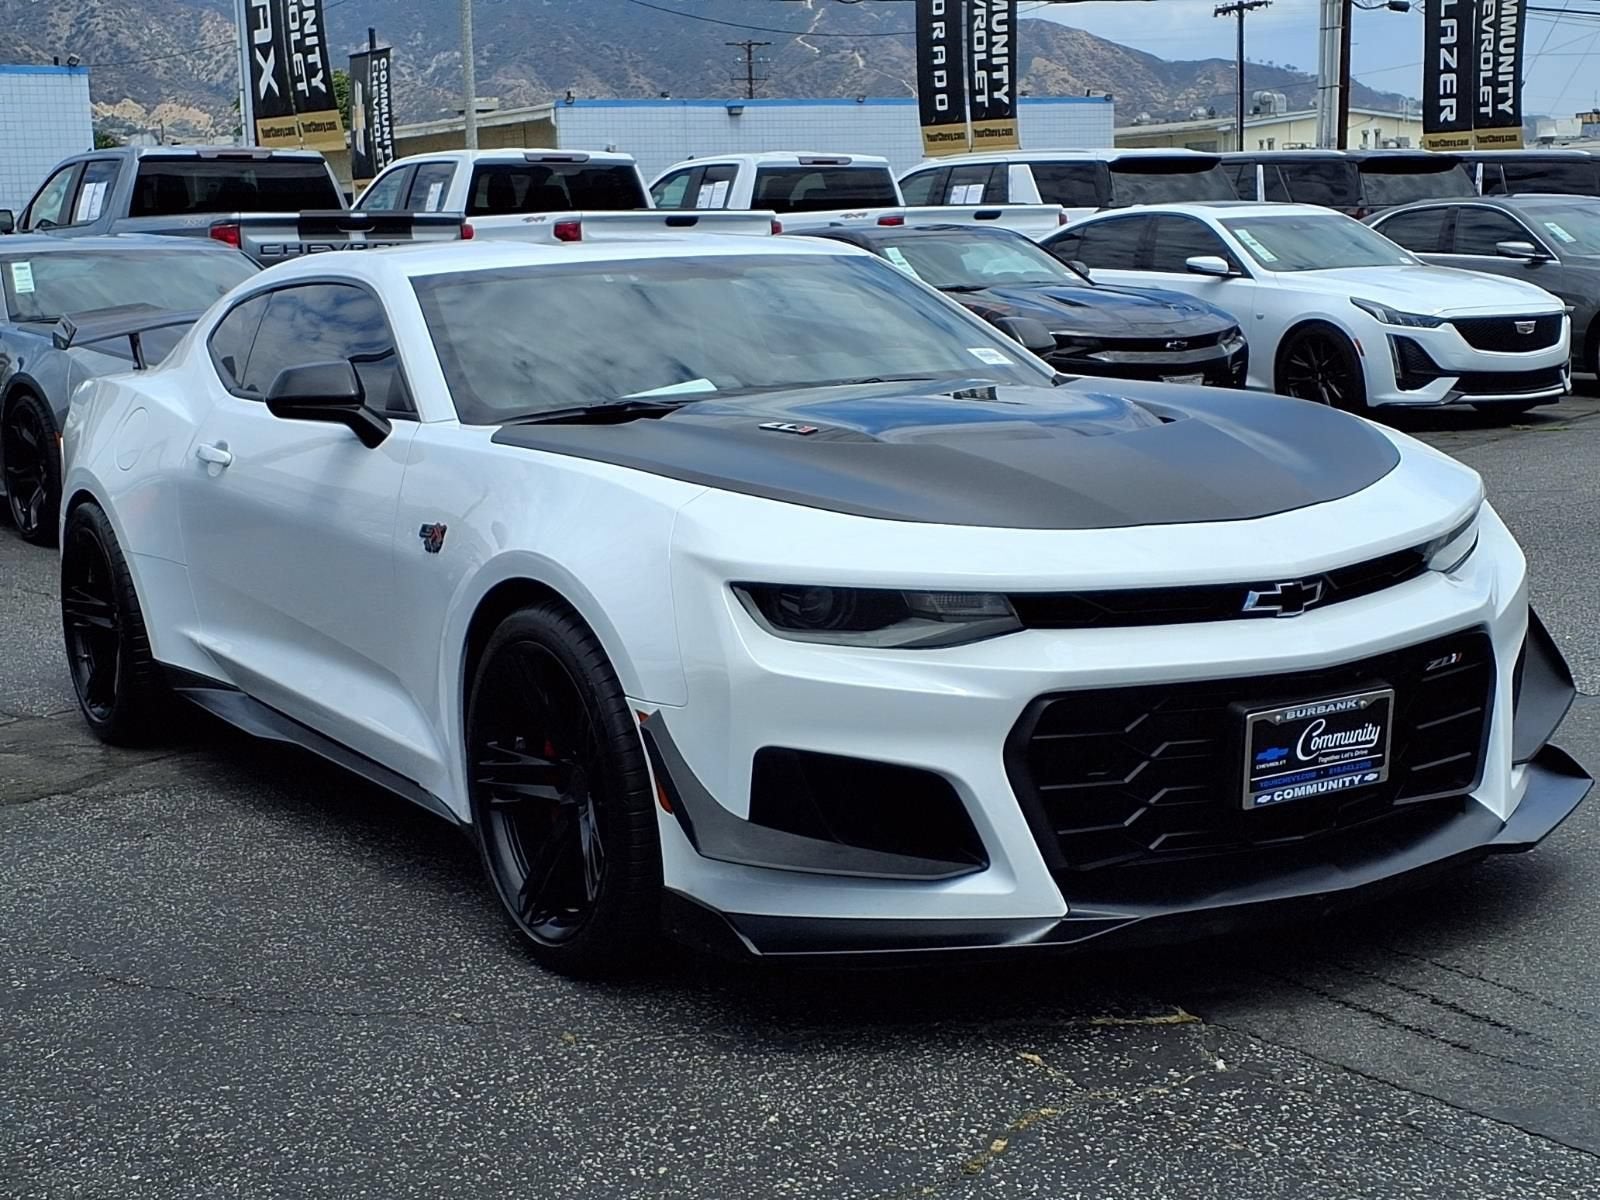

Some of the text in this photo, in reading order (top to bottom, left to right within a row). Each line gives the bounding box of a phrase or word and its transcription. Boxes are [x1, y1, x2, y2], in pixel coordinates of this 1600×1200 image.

[1285, 699, 1358, 720] BURBANK
[1296, 718, 1381, 761] Community
[1318, 752, 1340, 764] Together
[1354, 749, 1369, 758] Drive
[1273, 774, 1362, 802] COMMUNITY
